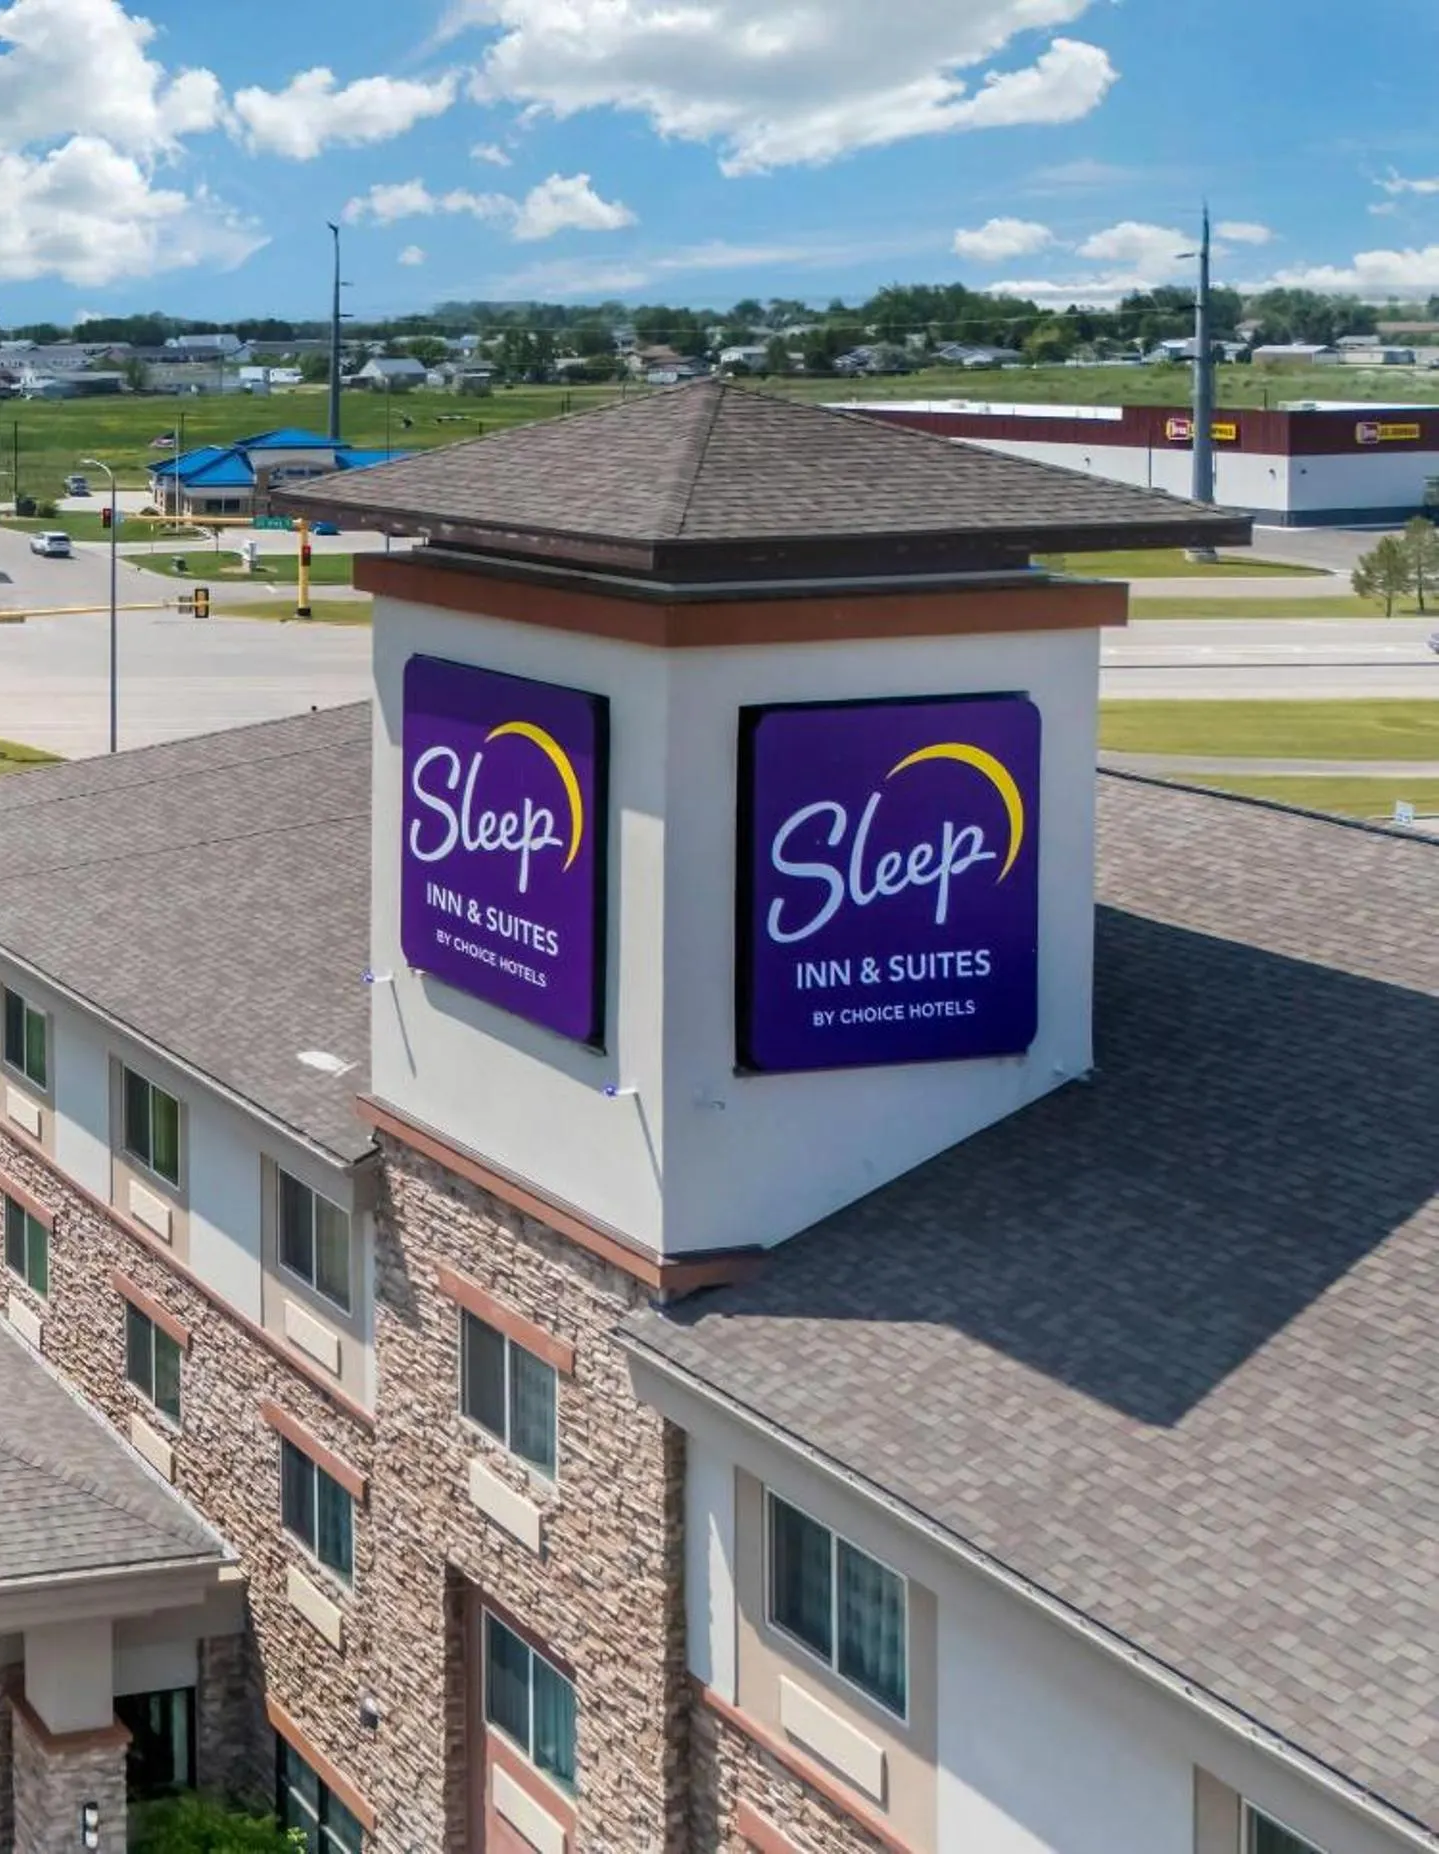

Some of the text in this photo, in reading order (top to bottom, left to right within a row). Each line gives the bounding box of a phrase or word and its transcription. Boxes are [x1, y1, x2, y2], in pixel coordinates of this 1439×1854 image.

[409, 745, 564, 894] Sleep
[767, 791, 997, 943] Sleep
[426, 881, 559, 957] INN & SUITES
[436, 929, 547, 988] BY CHOICE HOTELS
[796, 949, 991, 989] INN & SUITES
[813, 1000, 976, 1026] BY CHOICE HOTELS
